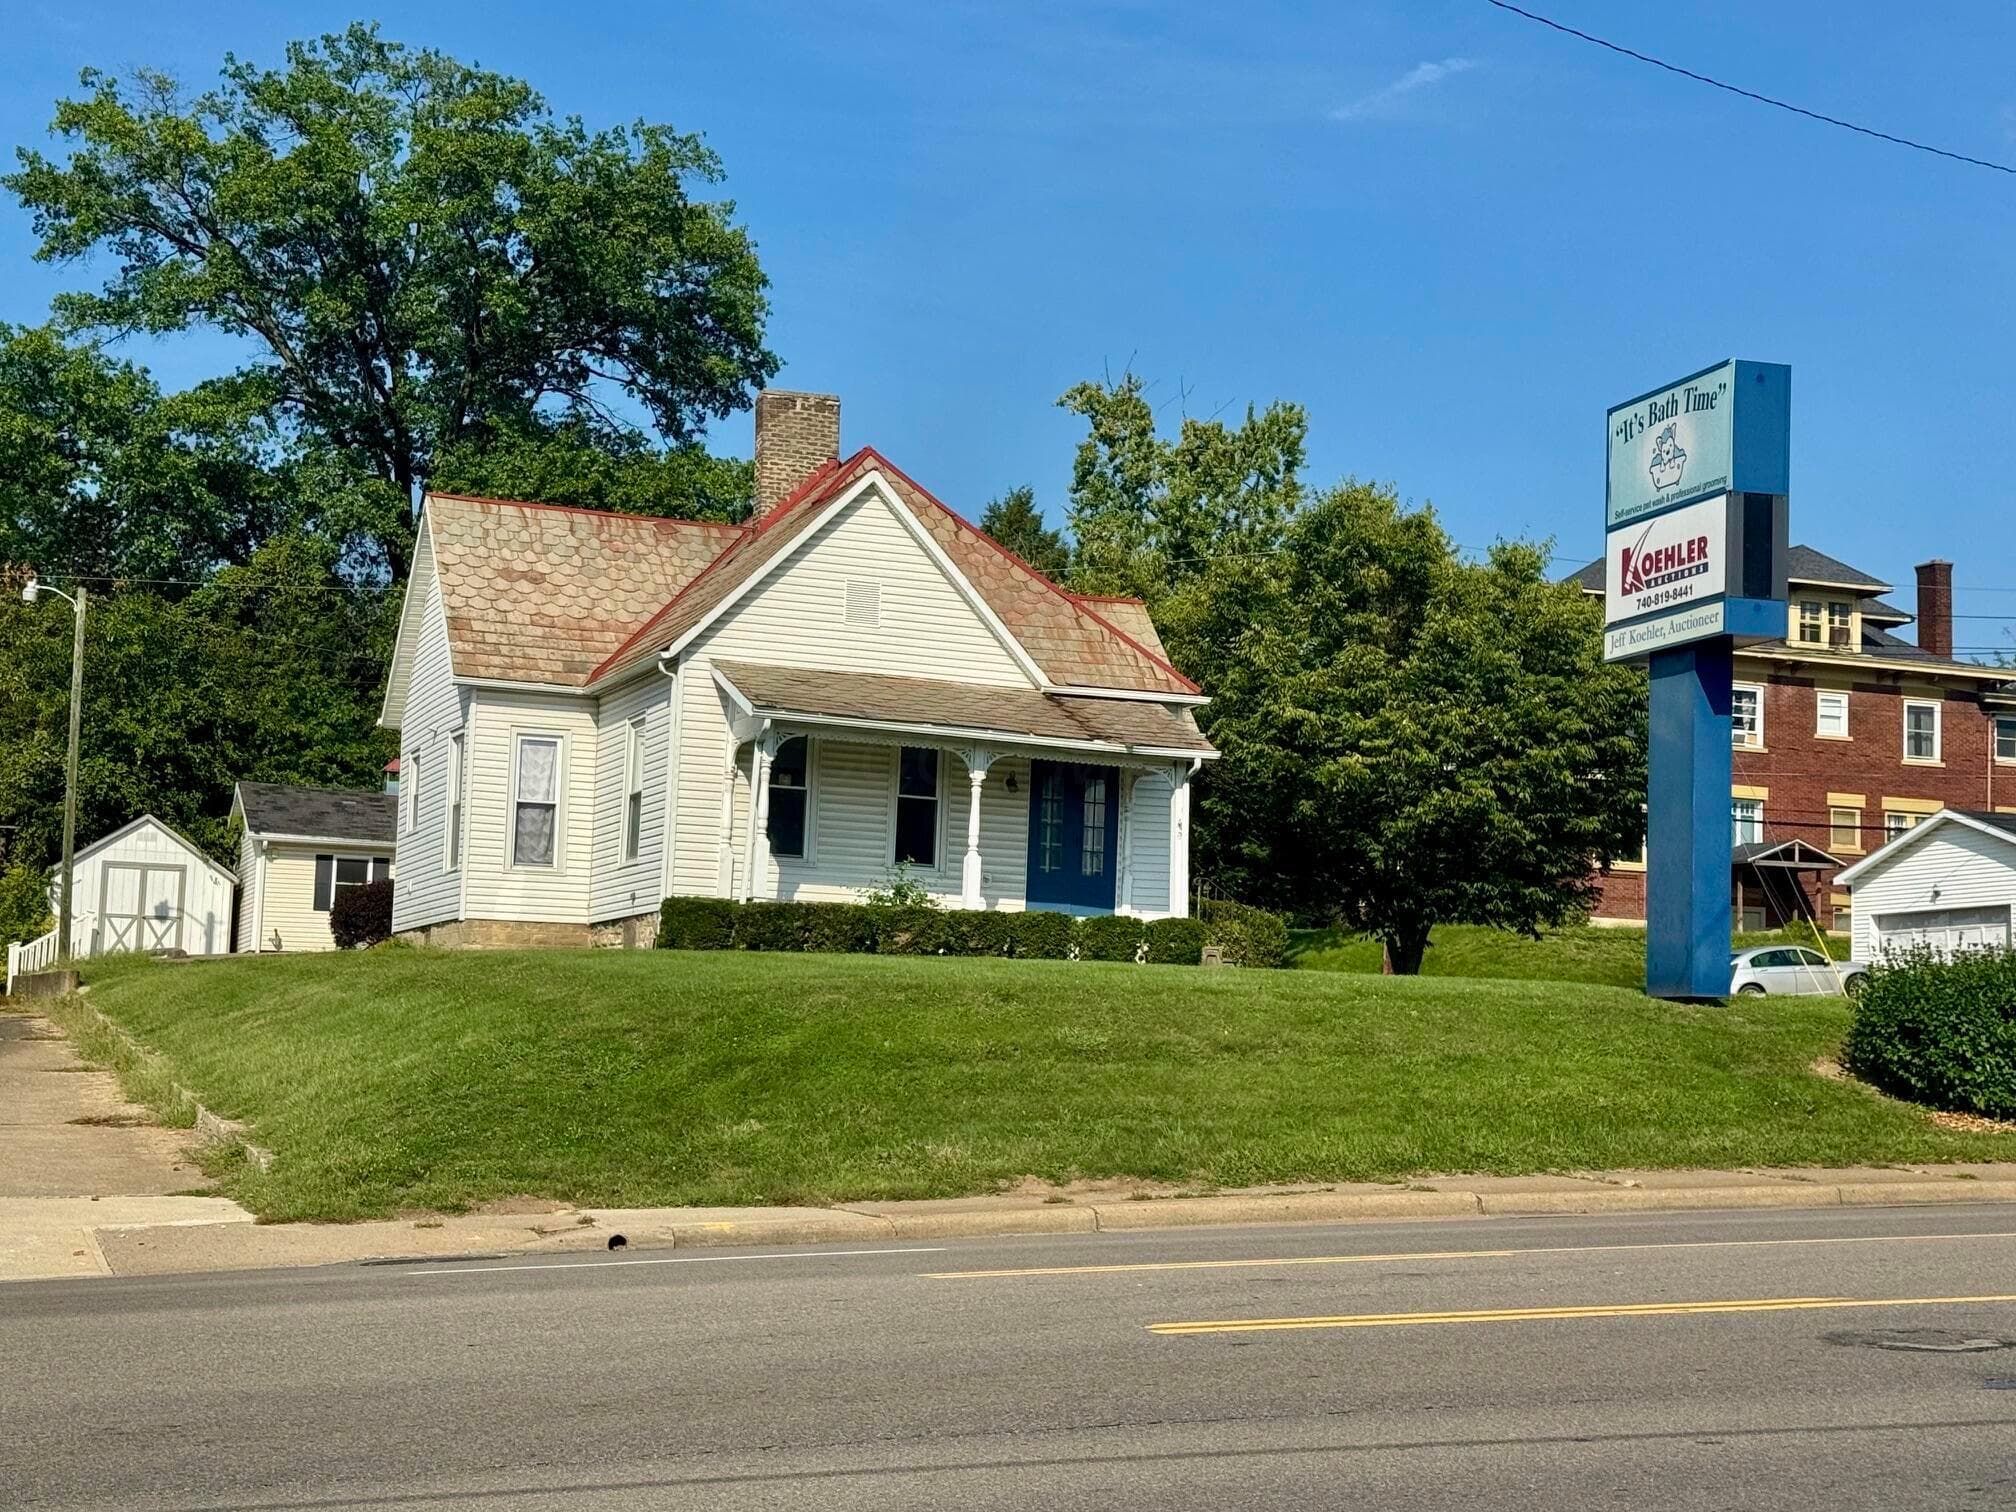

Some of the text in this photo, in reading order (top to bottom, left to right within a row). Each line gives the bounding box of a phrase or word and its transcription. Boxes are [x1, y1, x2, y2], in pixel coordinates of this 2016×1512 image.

[1648, 393, 1678, 428] Bath
[1684, 382, 1727, 414] Time"
[1614, 503, 1642, 520] Self-service
[1666, 493, 1670, 503] &
[1670, 484, 1700, 503] professional
[1702, 475, 1728, 492] grooming
[1621, 536, 1708, 597] KOEHLER
[1650, 566, 1704, 588] AUCTIONS
[1636, 583, 1693, 610] 740-819-8441
[1609, 611, 1719, 654] Jeff Koehler, Auctioneer
